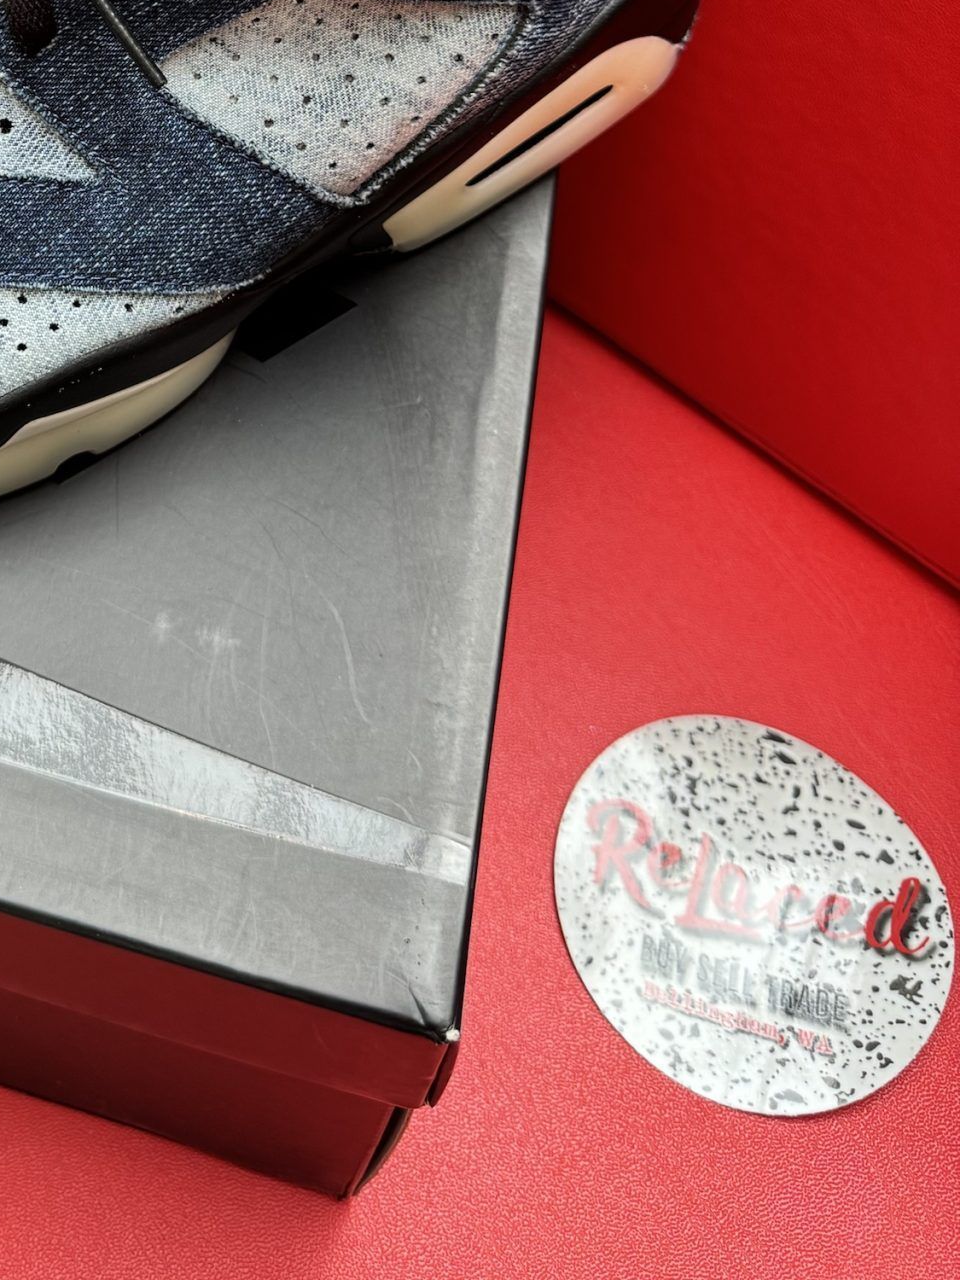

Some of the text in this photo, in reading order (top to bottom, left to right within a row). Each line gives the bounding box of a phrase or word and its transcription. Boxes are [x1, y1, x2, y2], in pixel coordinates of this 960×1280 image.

[641, 933, 849, 1023] BUY SELL TRADE
[797, 1028, 834, 1056] WA
